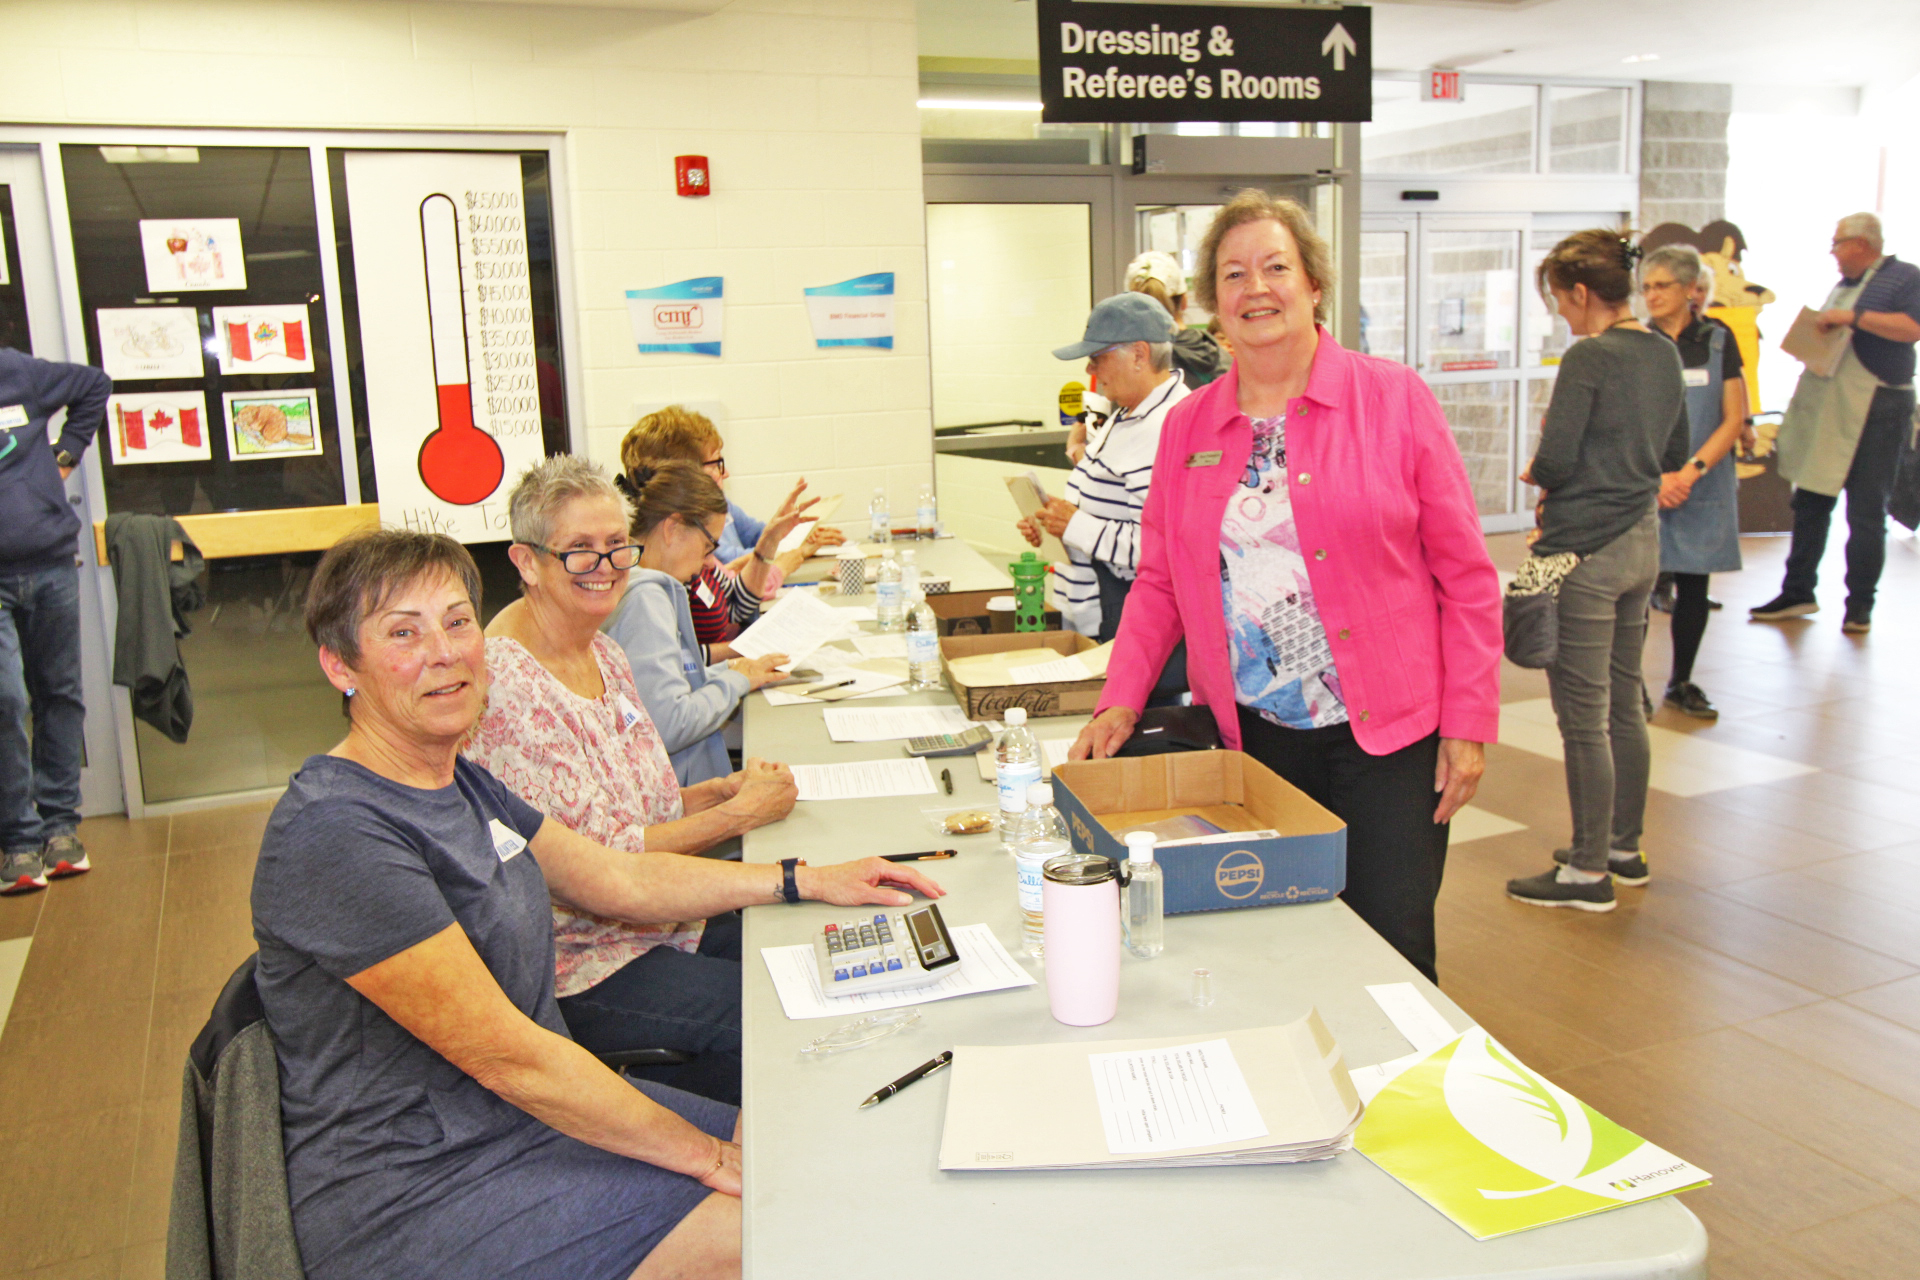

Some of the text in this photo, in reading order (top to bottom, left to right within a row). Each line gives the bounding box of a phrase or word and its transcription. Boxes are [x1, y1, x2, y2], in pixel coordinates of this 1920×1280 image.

[1060, 22, 1235, 63] Dressing &
[1062, 66, 1322, 100] Referee's Rooms
[1431, 71, 1459, 99] EXIT
[481, 329, 533, 348] $35,000
[482, 351, 534, 371] $30,000
[486, 374, 535, 393] $25,000
[487, 396, 537, 416] $20,000
[403, 507, 460, 534] Hike
[1071, 810, 1095, 854] PEPSI
[1219, 868, 1260, 881] PEPSI
[1628, 1162, 1687, 1184] Hanover
